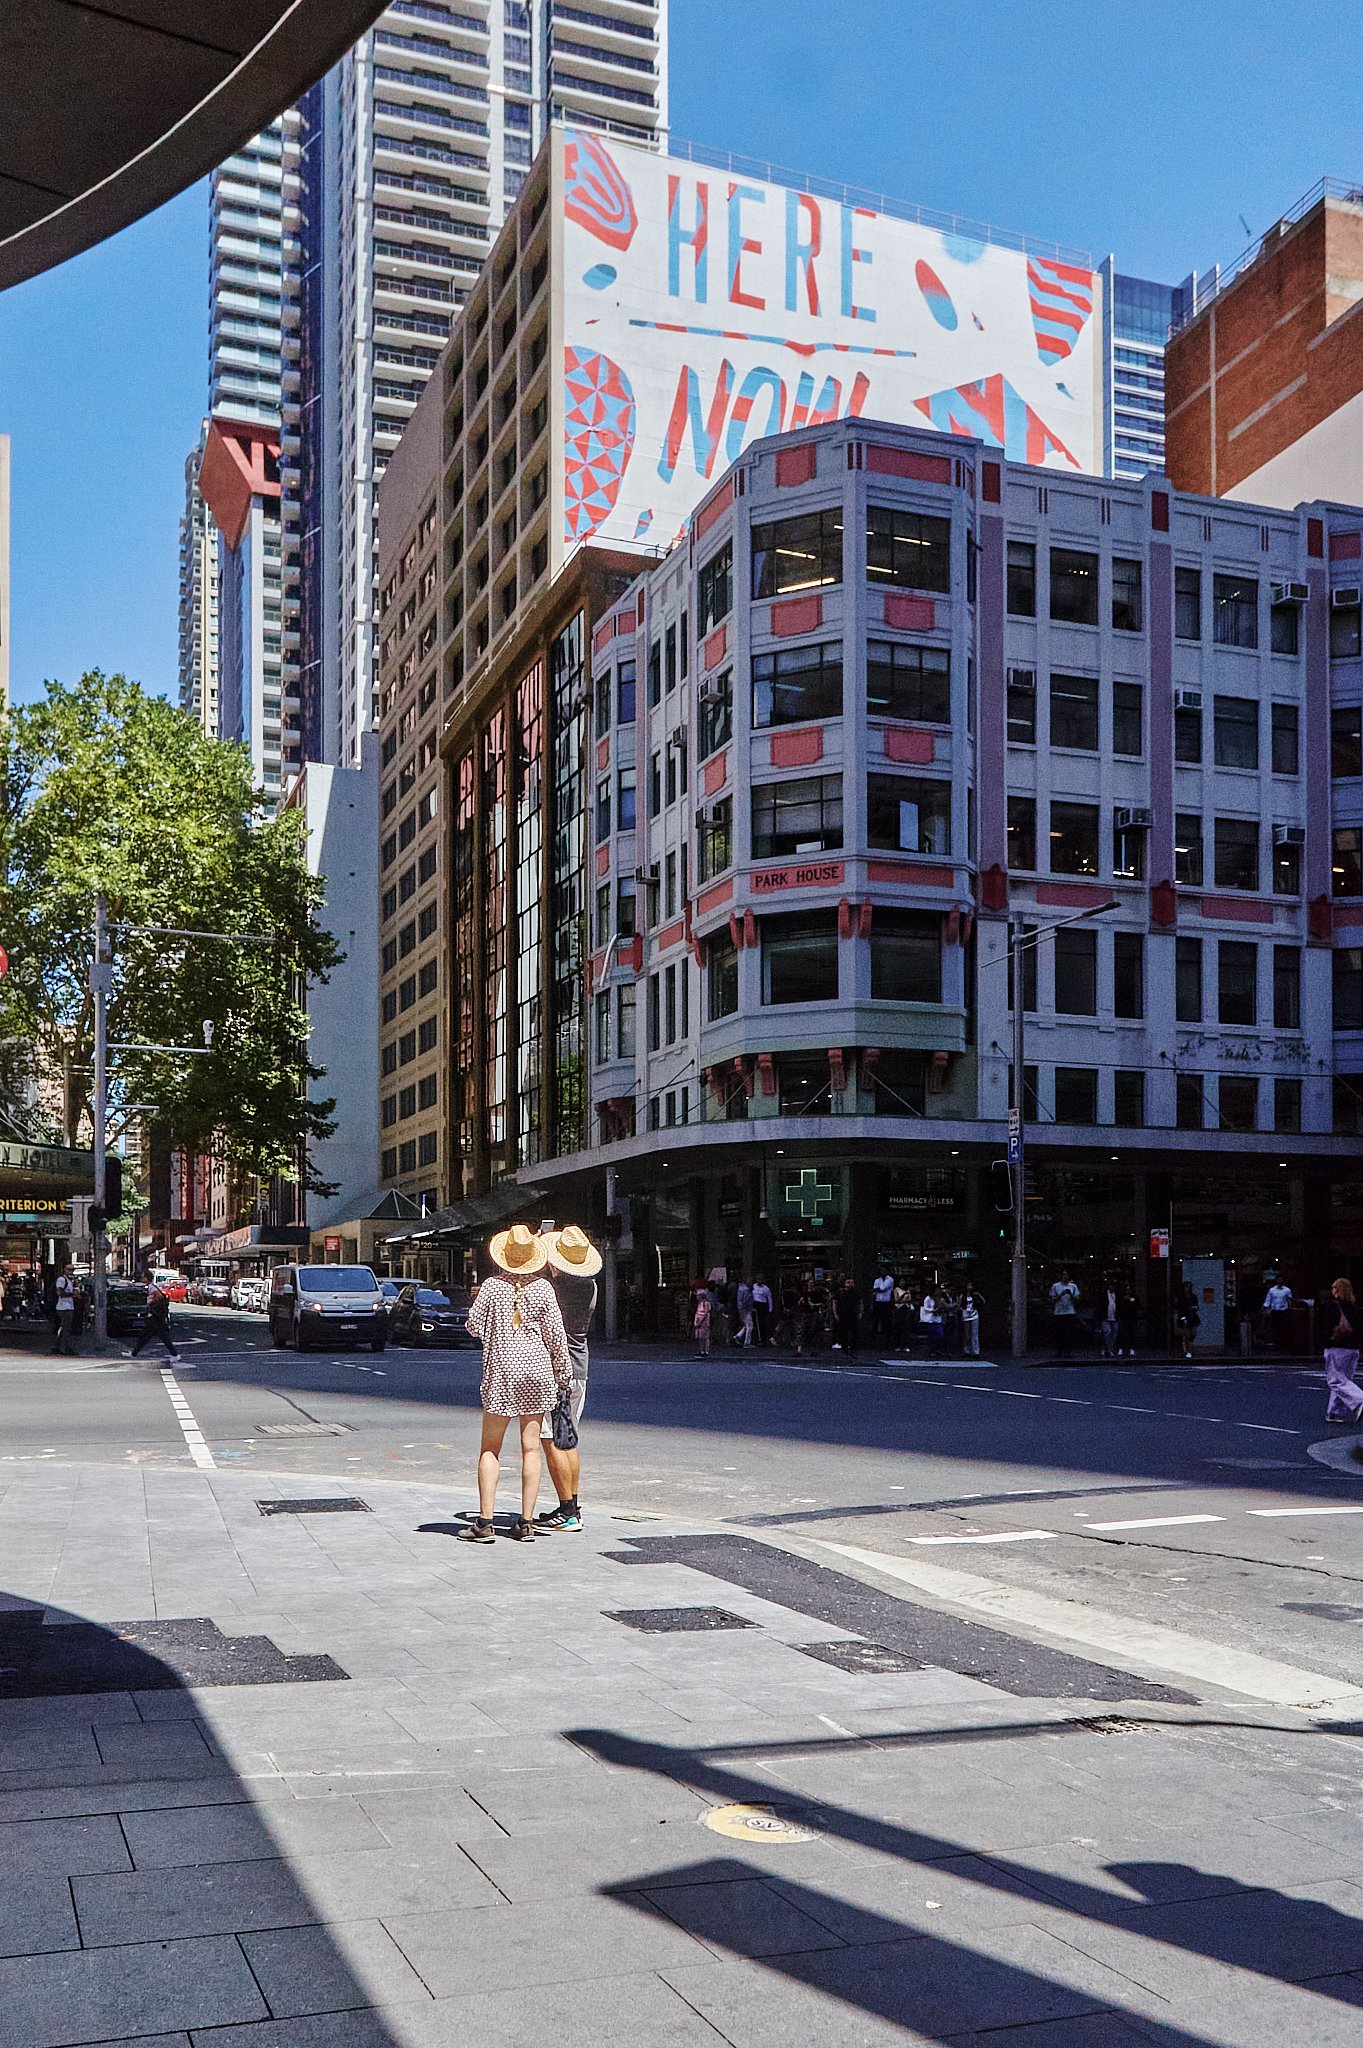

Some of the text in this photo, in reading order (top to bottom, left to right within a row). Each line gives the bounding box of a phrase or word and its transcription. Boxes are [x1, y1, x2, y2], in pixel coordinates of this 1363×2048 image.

[668, 174, 877, 323] HERE
[754, 866, 839, 887] PARK HOUSE
[1010, 1137, 1018, 1152] P
[889, 1196, 927, 1204] PHARMACY
